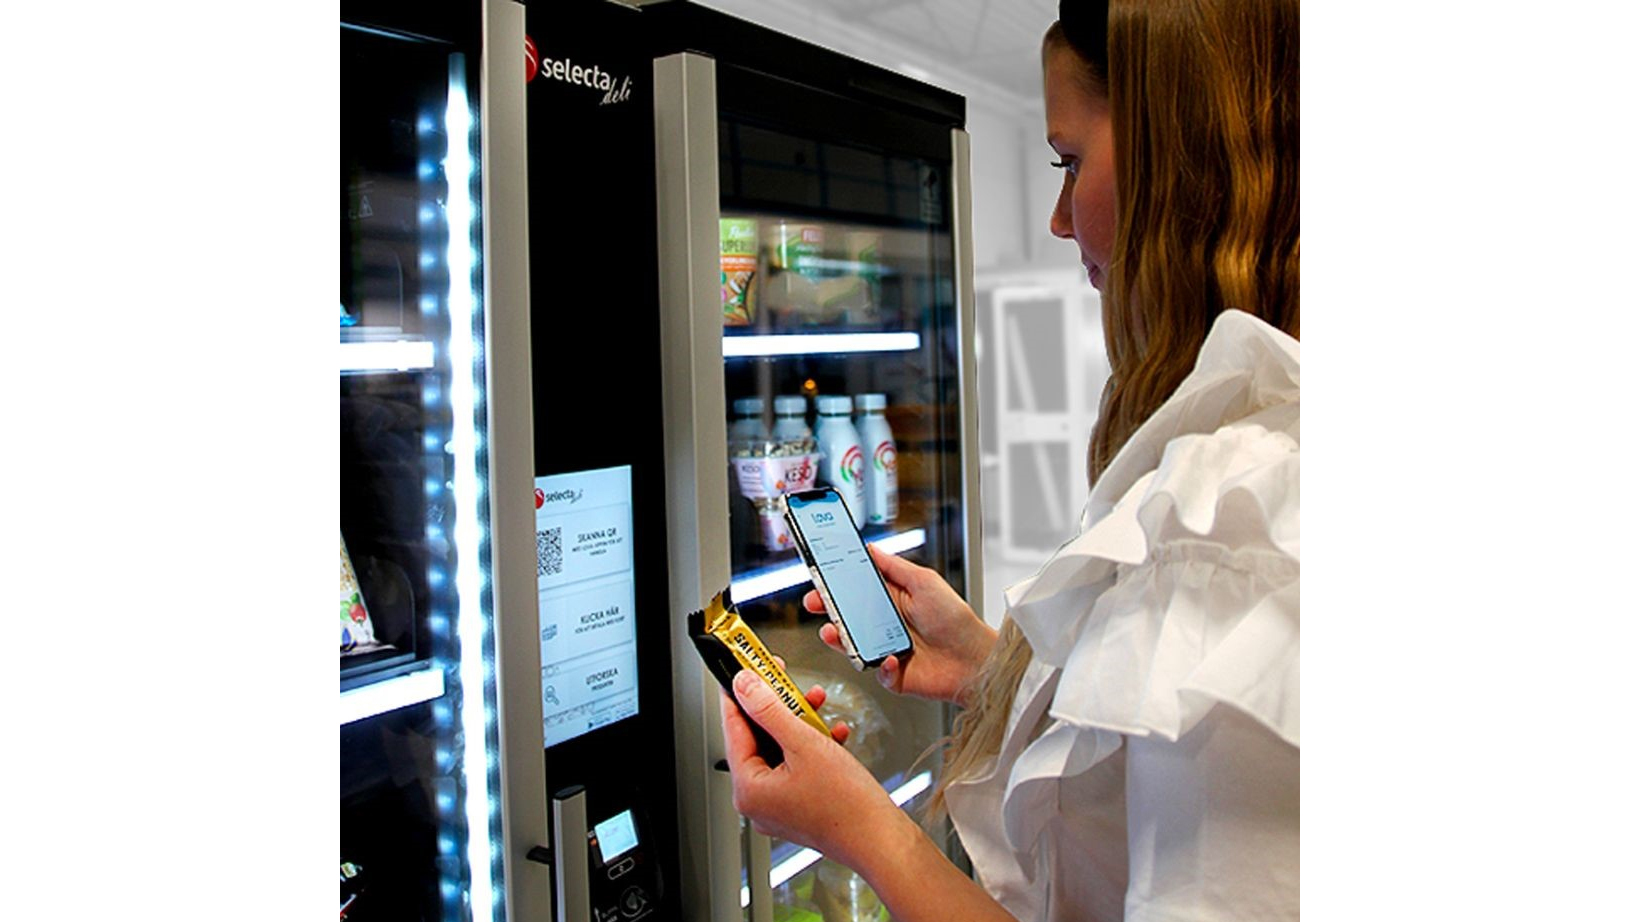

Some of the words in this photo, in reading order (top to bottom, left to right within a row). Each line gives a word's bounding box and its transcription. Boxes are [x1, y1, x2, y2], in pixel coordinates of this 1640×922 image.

[541, 57, 610, 91] selecta
[600, 76, 633, 105] deli
[785, 464, 812, 483] KESO
[546, 489, 575, 503] selecta
[578, 530, 606, 543] SKANNA
[734, 633, 765, 670] SALTY
[765, 671, 805, 717] PEANUT
